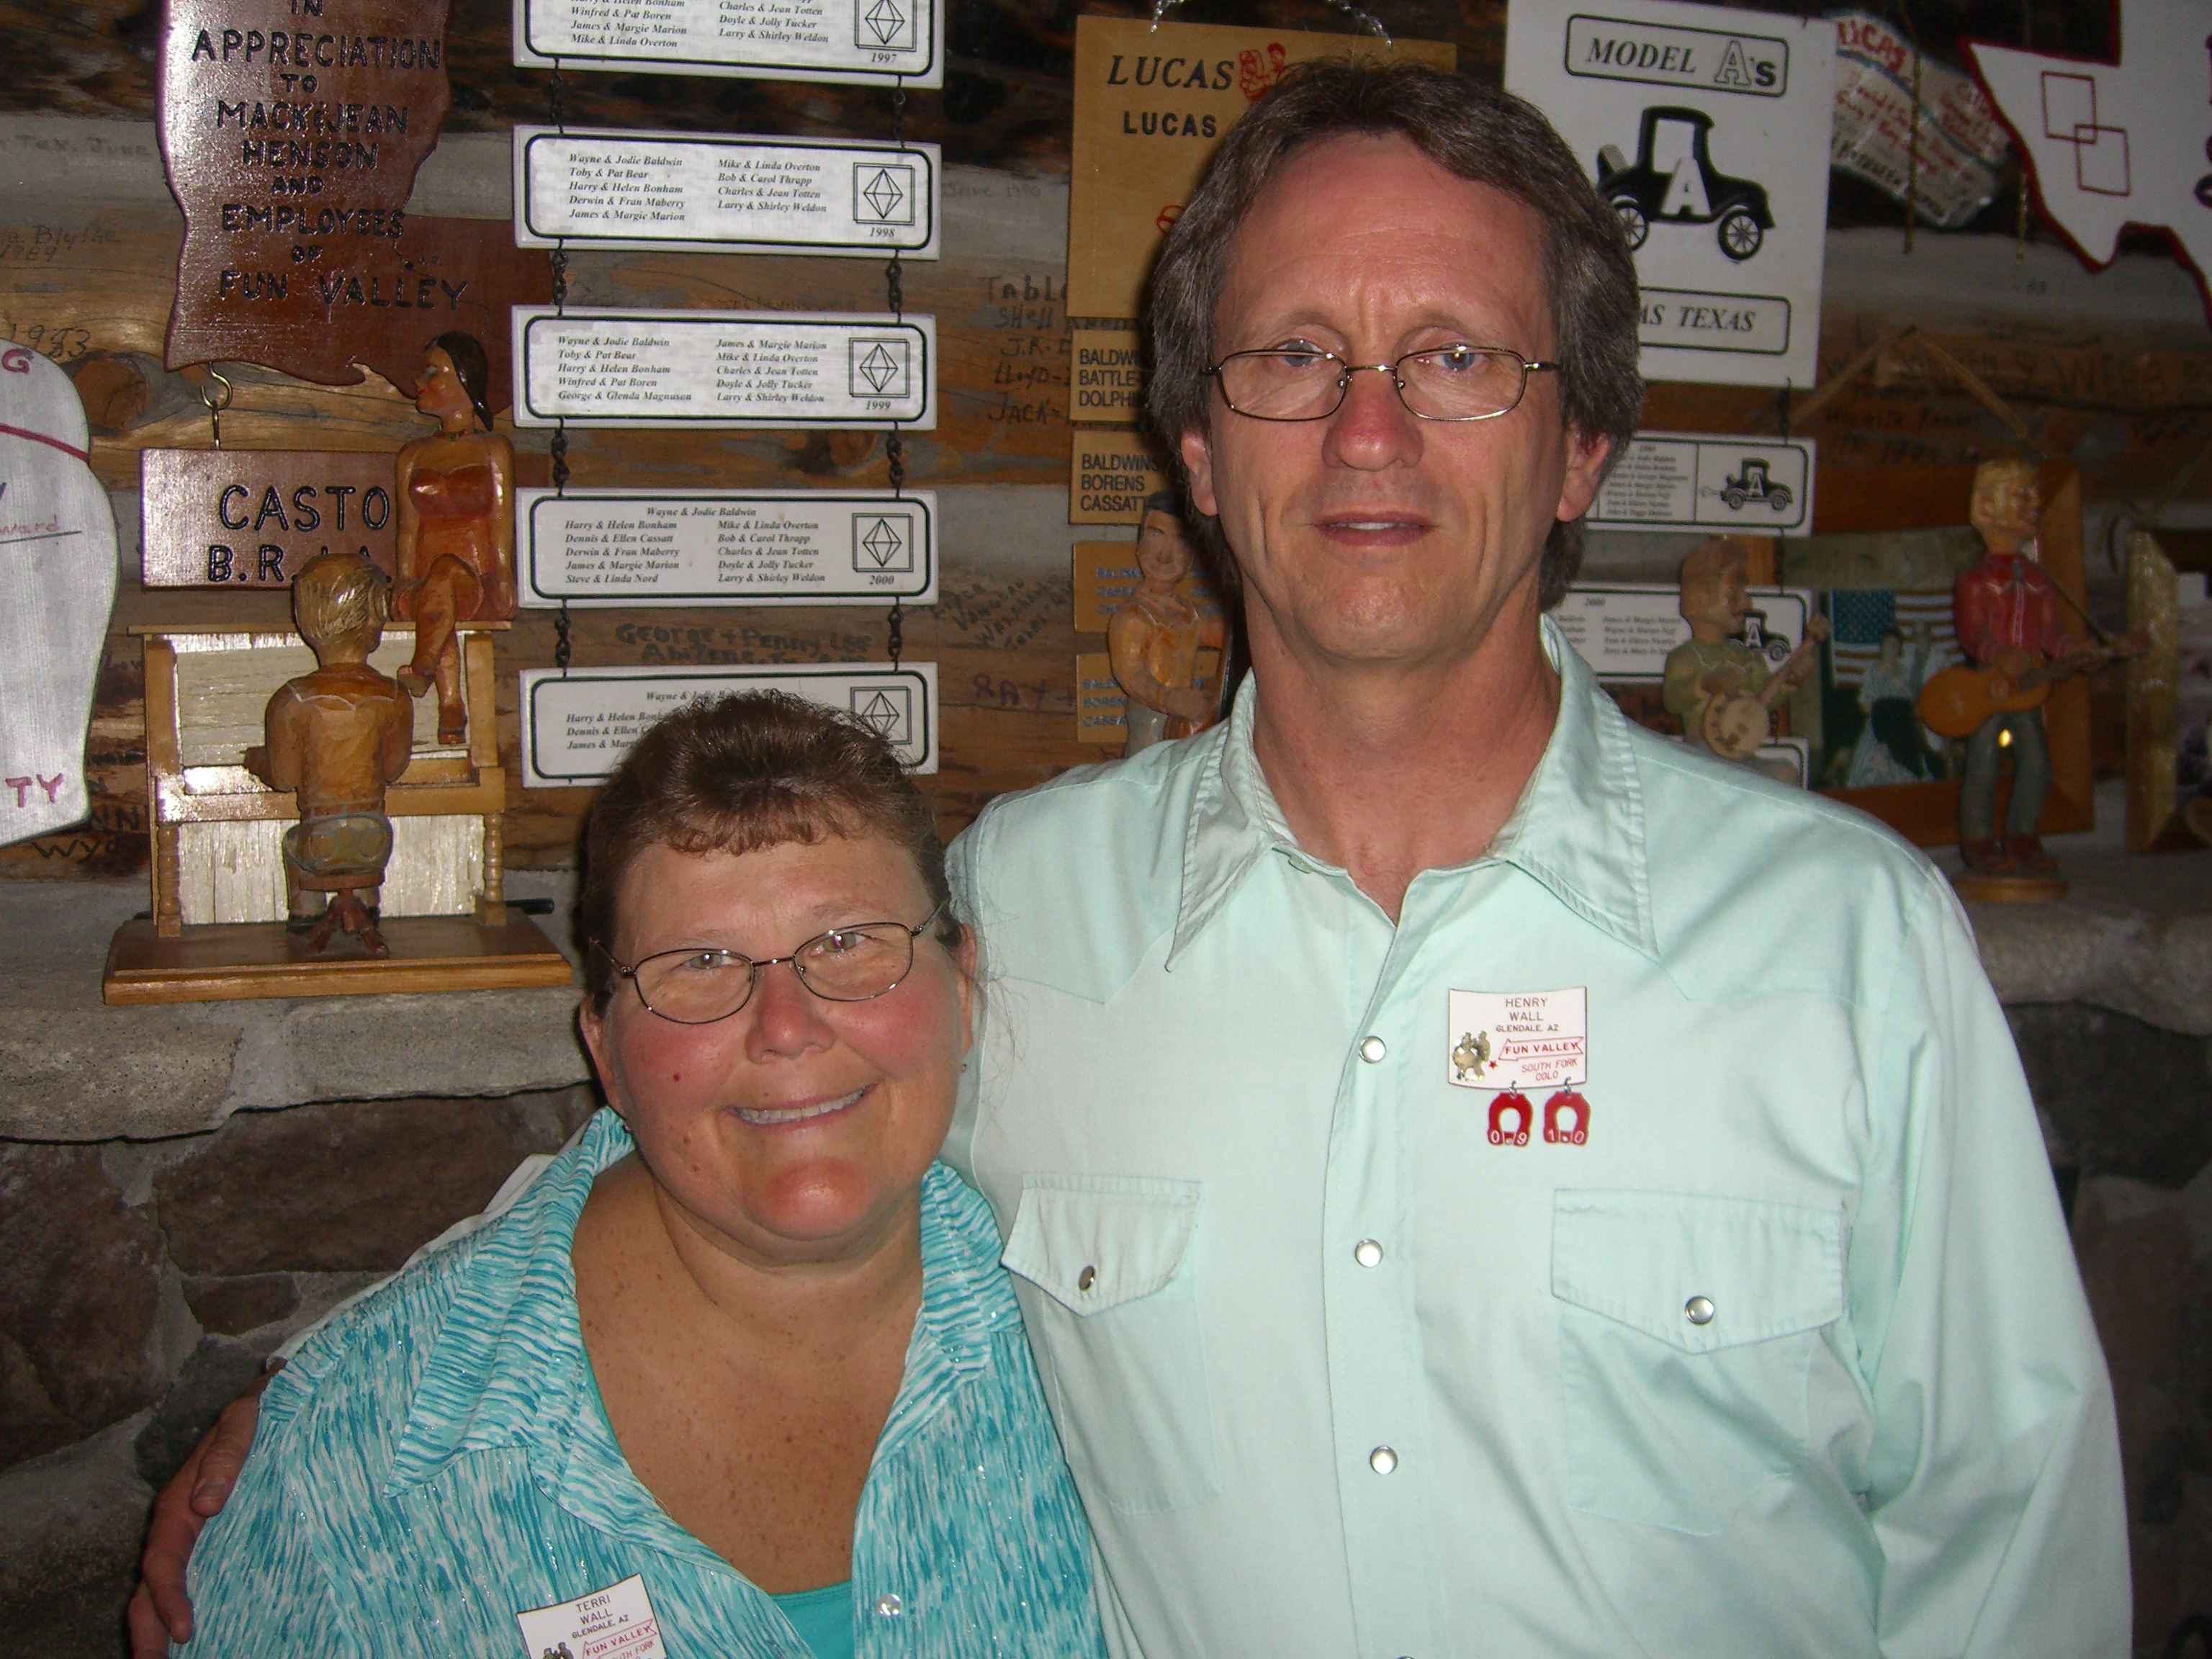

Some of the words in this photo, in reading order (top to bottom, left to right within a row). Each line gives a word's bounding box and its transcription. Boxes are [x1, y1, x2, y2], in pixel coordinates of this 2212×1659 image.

[570, 6, 610, 19] Winfred
[612, 8, 620, 17] &
[624, 9, 639, 19] Pat
[642, 9, 672, 20] Boren
[570, 34, 595, 45] Mike
[597, 35, 606, 45] &
[608, 35, 637, 46] Linda
[639, 37, 678, 48] Overton
[718, 28, 745, 40] Larry
[747, 30, 756, 39] &
[758, 30, 792, 43] Shirley
[793, 32, 829, 42] Weldon
[192, 30, 441, 70] APPRECIATION
[1587, 37, 1697, 74] MODEL
[871, 52, 896, 63] 1997
[1107, 55, 1235, 90] LUCAS
[281, 73, 318, 94] TO
[1123, 110, 1217, 137] LUCAS
[243, 140, 379, 170] HENSON
[568, 154, 601, 166] Wayne
[603, 155, 612, 165] &
[615, 156, 641, 166] Jodie
[643, 156, 683, 167] Baldwin
[271, 176, 324, 194] AND
[717, 173, 737, 182] Bob
[739, 174, 747, 183] &
[750, 174, 776, 184] Carol
[778, 175, 812, 187] Thrapp
[568, 181, 598, 194] Harry
[600, 182, 608, 192] &
[611, 183, 640, 193] Helen
[643, 184, 683, 194] Bonham
[568, 195, 604, 205] Derwin
[606, 197, 615, 206] &
[619, 197, 642, 207] Fran
[644, 197, 685, 210] Maberry
[222, 204, 405, 239] EMPLOYEES
[870, 227, 895, 238] 1998
[292, 245, 323, 264] OF
[219, 271, 287, 300] FUN
[319, 276, 469, 310] VALLEY
[1679, 305, 1757, 333] TEXAS
[715, 339, 745, 349] James
[747, 339, 755, 349] &
[758, 340, 792, 351] Margie
[793, 340, 827, 350] Marion
[716, 366, 752, 375] Charles
[754, 366, 762, 375] &
[765, 366, 788, 376] Jean
[789, 367, 819, 376] Totten
[714, 379, 743, 390] Doyle
[745, 379, 752, 389] &
[756, 379, 778, 391] Jolly
[781, 379, 812, 390] Tucker
[557, 391, 592, 403] George
[594, 391, 603, 400] &
[606, 391, 640, 401] Glenda
[642, 392, 692, 403] Magnuson
[866, 400, 891, 410] 1999
[1082, 474, 1146, 491] BORENS
[646, 507, 678, 518] Wayne
[680, 507, 688, 516] &
[691, 507, 716, 517] Jodie
[718, 508, 757, 517] Baldwin
[565, 534, 598, 543] Dennis
[601, 534, 609, 543] &
[612, 534, 637, 543] Ellen
[639, 534, 673, 543] Cassatt
[717, 559, 745, 571] Doyle
[746, 559, 755, 569] &
[757, 559, 780, 572] Jolly
[782, 560, 814, 570] Tucker
[565, 573, 590, 583] Steve
[593, 573, 601, 583] &
[604, 573, 632, 583] Linda
[634, 573, 658, 583] Nord
[717, 572, 744, 585] Larry
[745, 573, 755, 583] &
[756, 573, 788, 585] Shirley
[791, 573, 826, 583] Weldon
[869, 575, 894, 585] 2000
[647, 691, 677, 702] Wayne
[566, 714, 593, 724] Harry
[596, 713, 606, 721] &
[608, 713, 636, 721] Helen
[566, 727, 599, 736] Dennis
[602, 727, 611, 735] &
[613, 726, 638, 734] Ellen
[567, 740, 596, 750] James
[599, 739, 607, 748] &
[1506, 997, 1548, 1007] HENRY
[1509, 1011, 1544, 1022] WALL
[1506, 1046, 1529, 1055] FUN
[1533, 1042, 1578, 1053] VALLEY
[1521, 1062, 1552, 1074] SOUTH
[1555, 1058, 1578, 1068] FORK
[1535, 1071, 1559, 1082] COLO
[575, 1593, 611, 1612] TERRI
[580, 1609, 613, 1625] WALL
[619, 1614, 630, 1624] AZ
[585, 1642, 608, 1656] FUN
[611, 1625, 650, 1646] VALLEY
[635, 1639, 655, 1655] FORK
